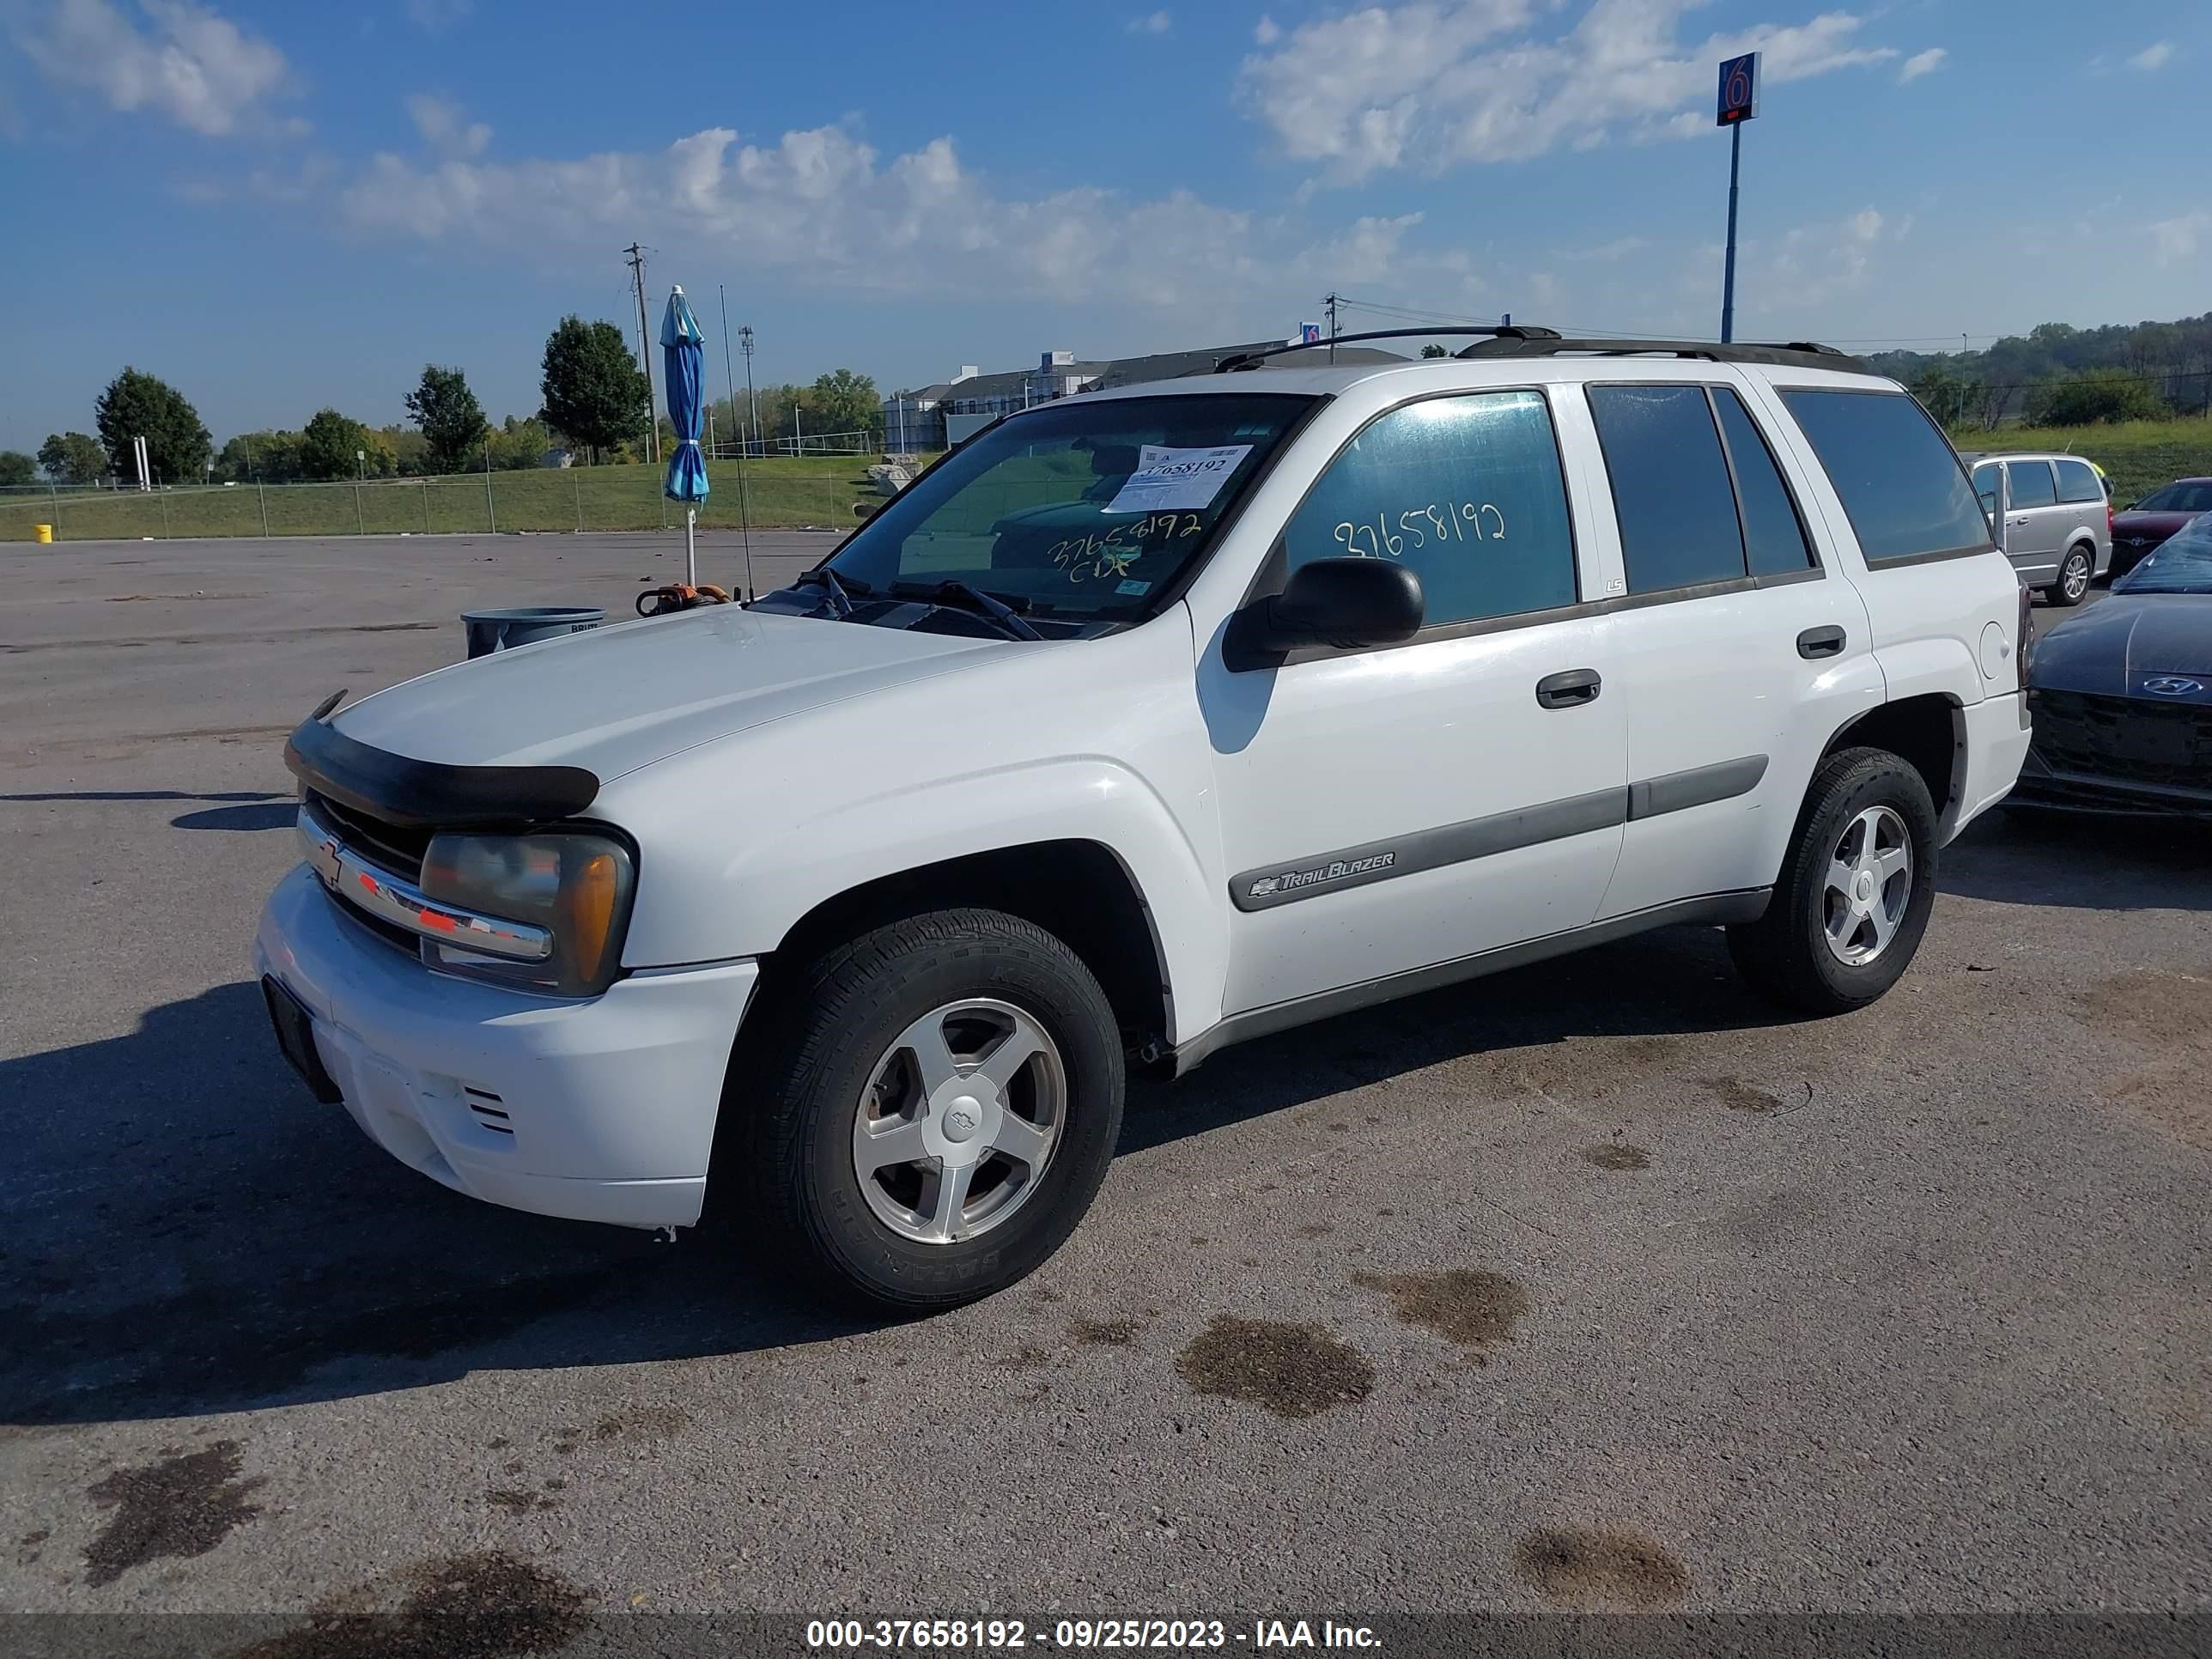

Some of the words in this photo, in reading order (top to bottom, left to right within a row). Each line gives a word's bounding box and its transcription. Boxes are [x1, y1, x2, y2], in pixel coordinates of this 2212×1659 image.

[1725, 57, 1749, 109] 6
[1140, 460, 1226, 477] 37658192
[1047, 514, 1201, 572] 37658192
[1607, 578, 1622, 592] LS
[1280, 853, 1395, 890] TRAILBLAZER
